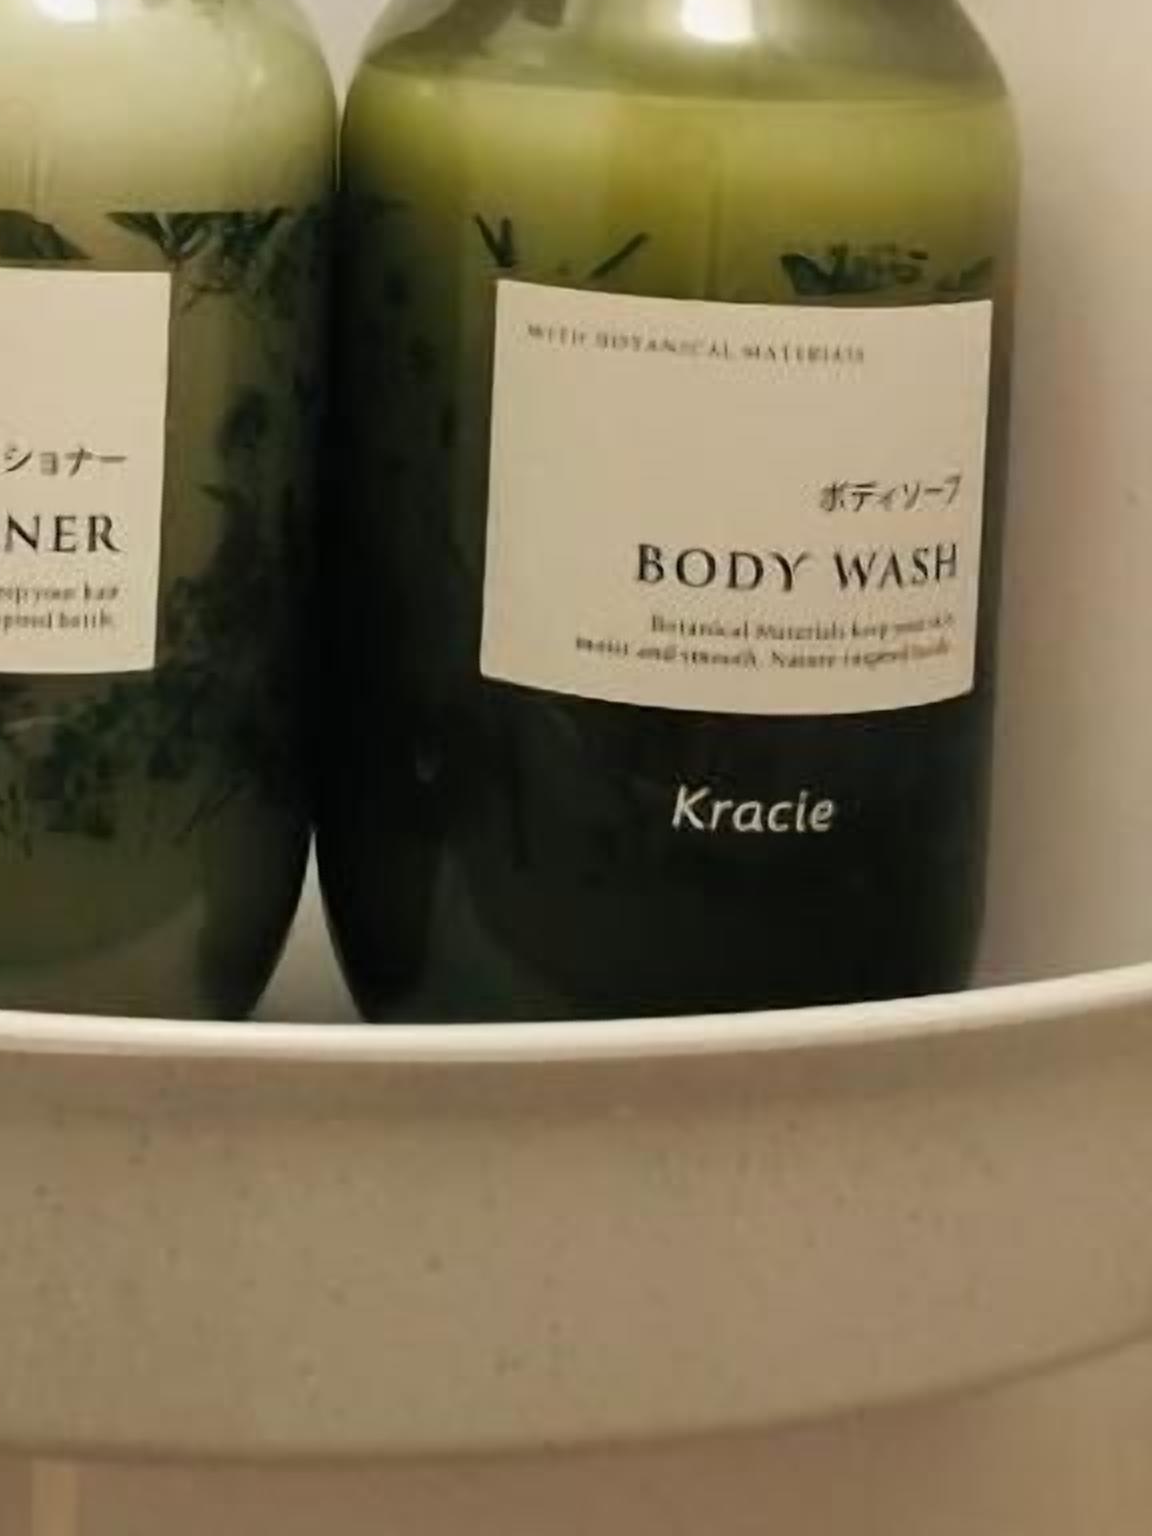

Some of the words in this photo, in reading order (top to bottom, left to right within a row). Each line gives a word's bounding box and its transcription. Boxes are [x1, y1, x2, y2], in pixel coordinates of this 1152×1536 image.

[596, 330, 730, 362] BOTANICAL
[635, 542, 812, 594] BODY
[832, 540, 959, 592] WASH
[670, 782, 836, 835] Kracie
